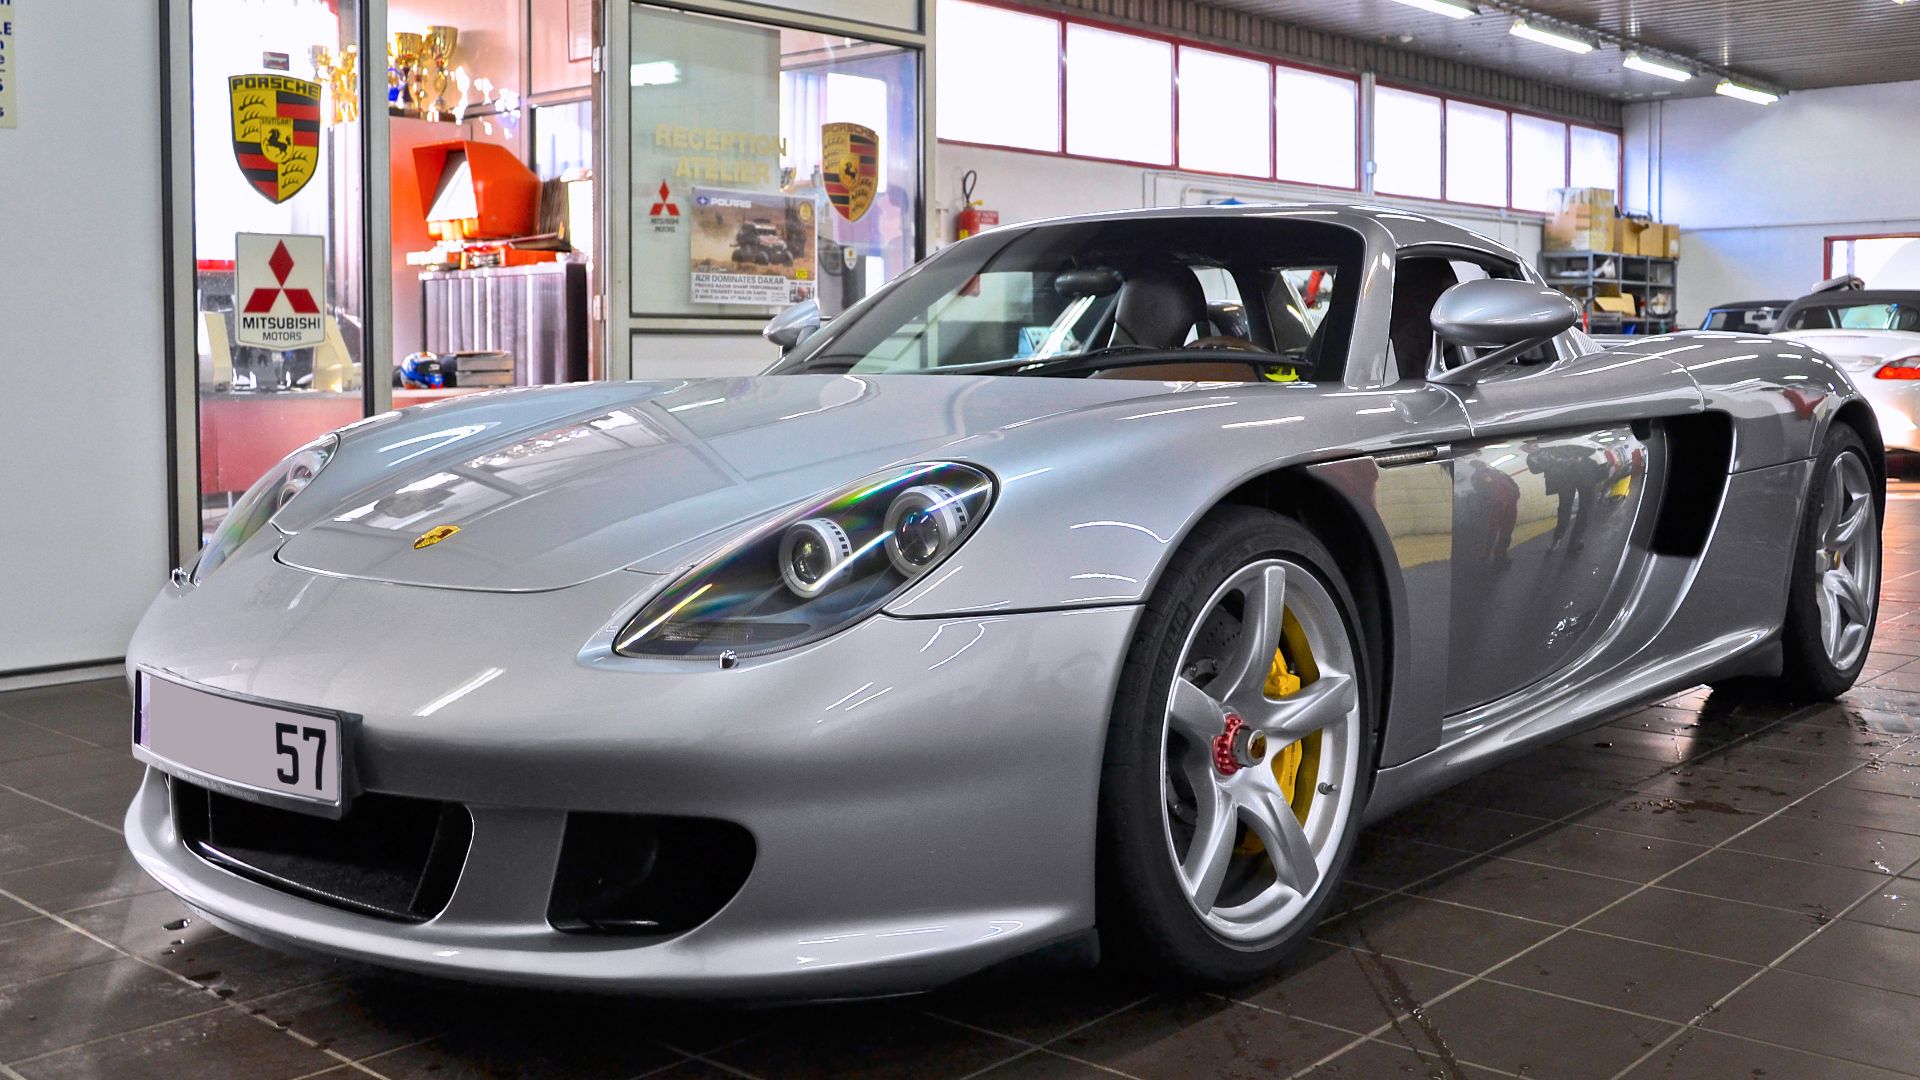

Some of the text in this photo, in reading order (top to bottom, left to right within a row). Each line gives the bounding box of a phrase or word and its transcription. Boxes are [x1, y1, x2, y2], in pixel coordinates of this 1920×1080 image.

[232, 77, 319, 98] PORSCHE
[655, 123, 787, 157] RECEPTION
[674, 155, 770, 184] ATELIER
[710, 197, 752, 209] POLARIS
[695, 274, 710, 282] RZR
[711, 274, 756, 284] DOMINATES
[757, 276, 784, 285] DAKAR
[242, 317, 320, 329] MITSUBISHI
[262, 331, 302, 341] MOTORS
[275, 722, 327, 791] 57
